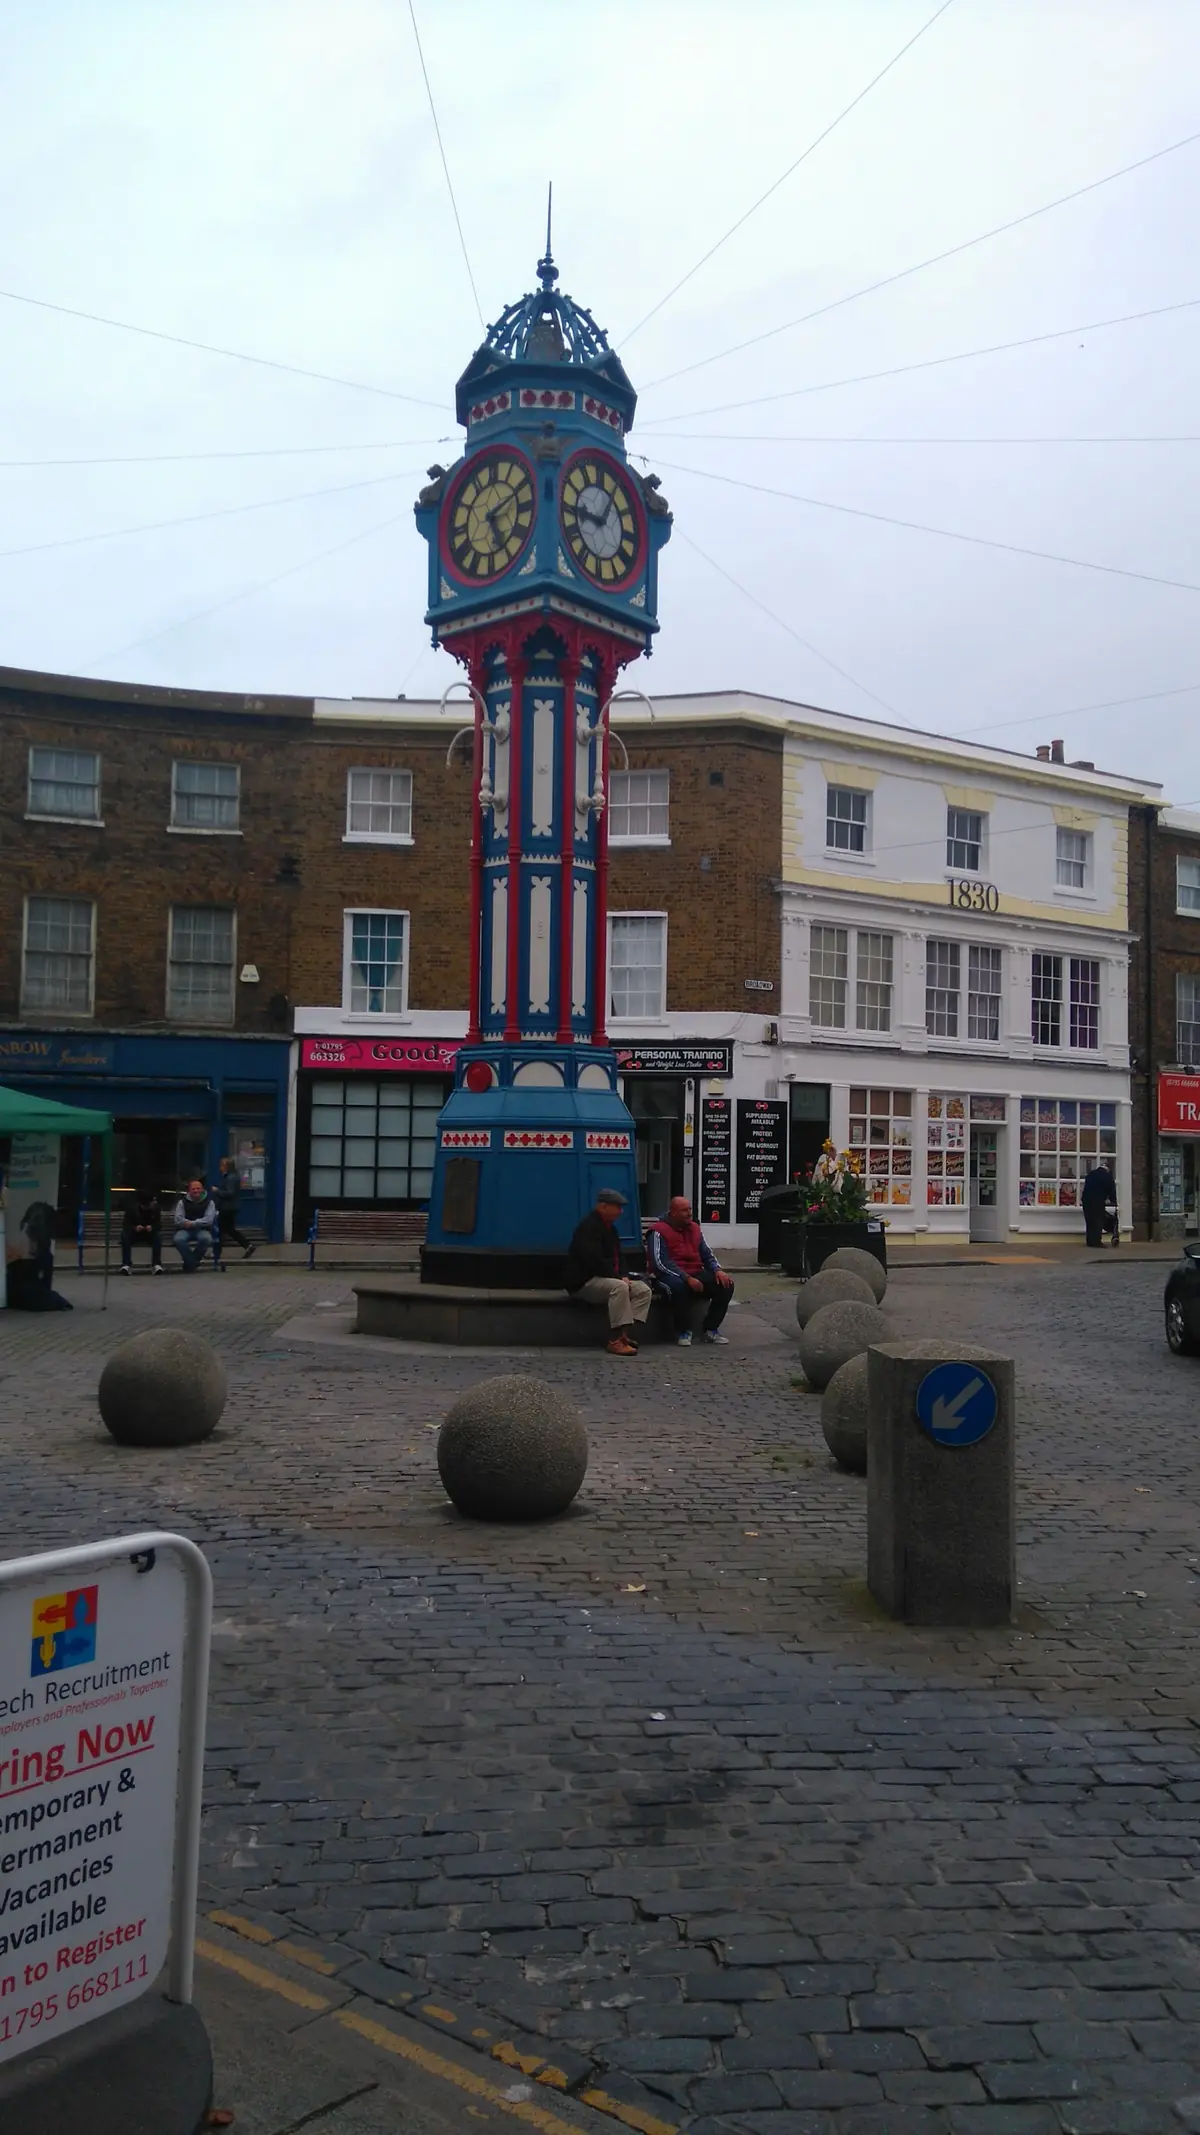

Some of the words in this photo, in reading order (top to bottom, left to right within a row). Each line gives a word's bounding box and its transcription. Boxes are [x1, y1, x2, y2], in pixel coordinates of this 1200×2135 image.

[948, 879, 998, 912] 1830
[310, 1053, 346, 1062] 663326
[372, 1044, 439, 1061] Good
[635, 1051, 681, 1059] PERSONAL
[683, 1051, 723, 1060] TRAINING
[45, 1651, 171, 1704] Recruitment
[43, 1708, 62, 1723] and
[65, 1690, 126, 1716] Professionals
[130, 1678, 169, 1698] Together
[78, 1716, 155, 1763] Now
[117, 1767, 136, 1793] &
[0, 1894, 106, 1956] available
[24, 1962, 48, 1986] to
[56, 1918, 147, 1972] Register
[67, 1954, 149, 2010] 668111
